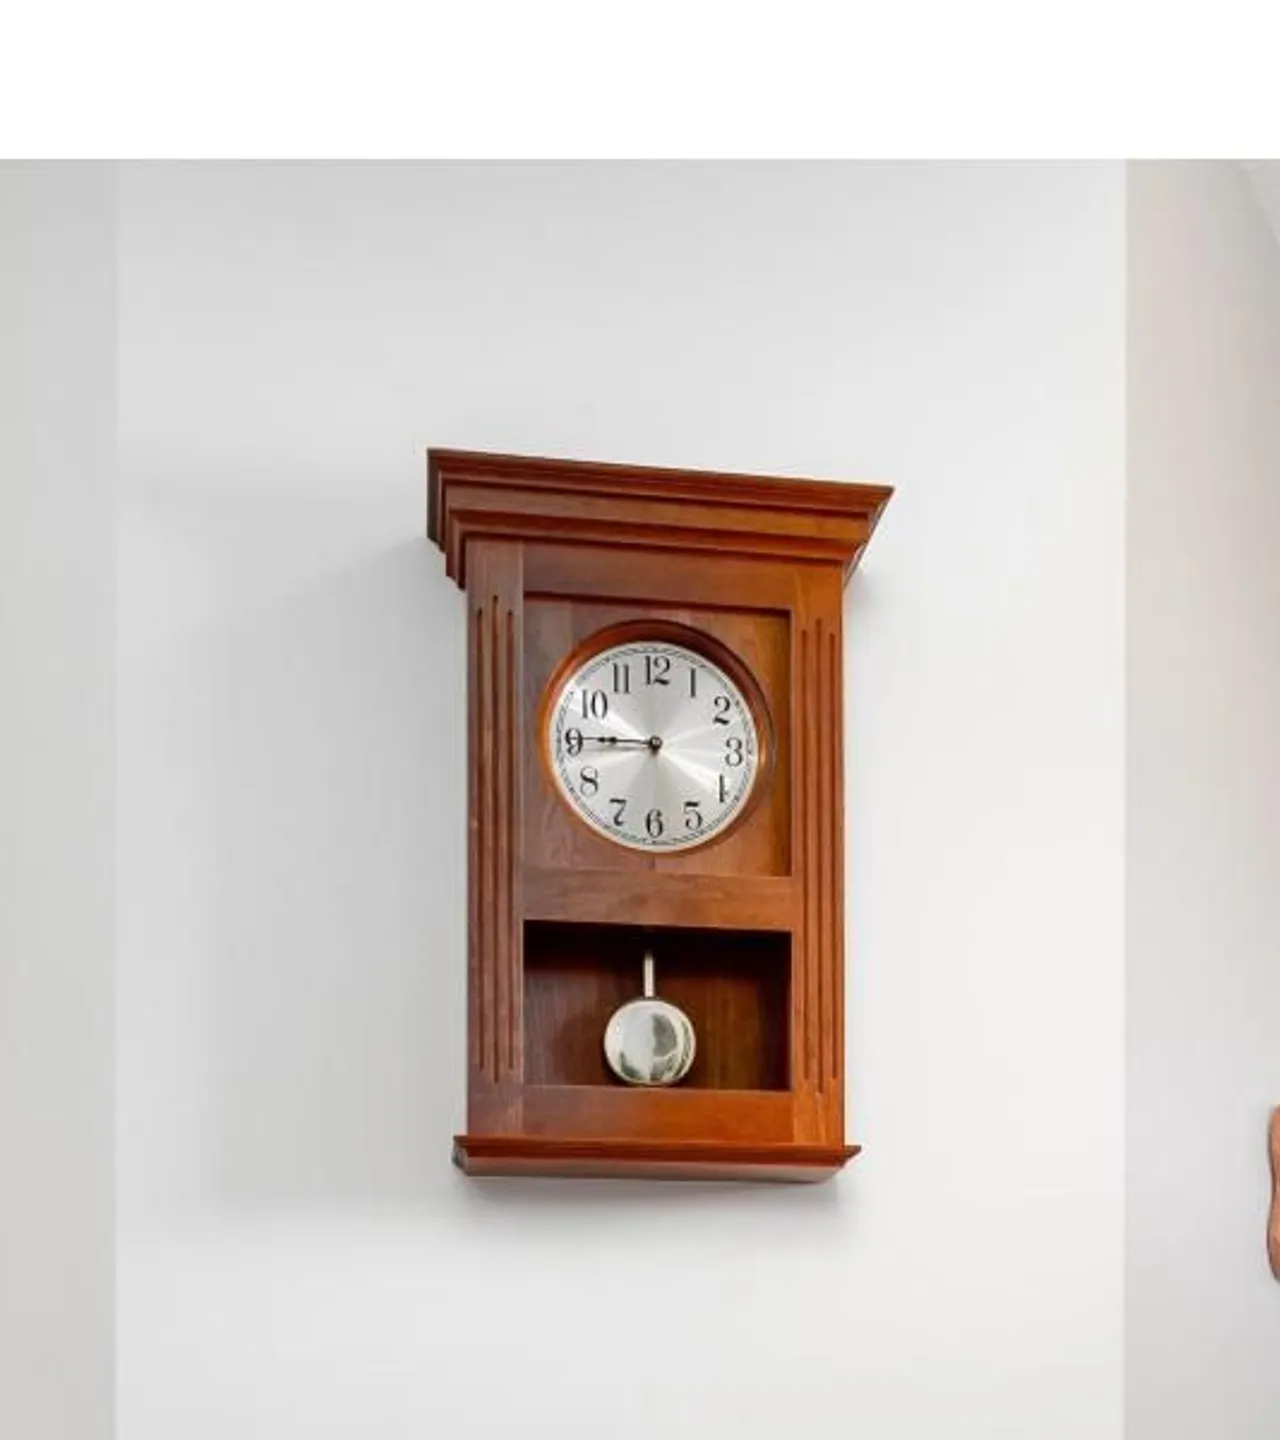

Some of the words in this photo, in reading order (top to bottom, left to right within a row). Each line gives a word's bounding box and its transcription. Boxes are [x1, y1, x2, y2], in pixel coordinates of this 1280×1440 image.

[613, 663, 630, 694] 11
[644, 655, 670, 685] 12
[690, 668, 697, 698] 1
[581, 690, 608, 719] 10
[713, 697, 731, 726] 2
[565, 728, 583, 756] 9
[724, 738, 743, 766] 3
[580, 767, 598, 796] 8
[610, 799, 627, 826] 7
[646, 810, 663, 837] 6
[684, 802, 703, 830] 5
